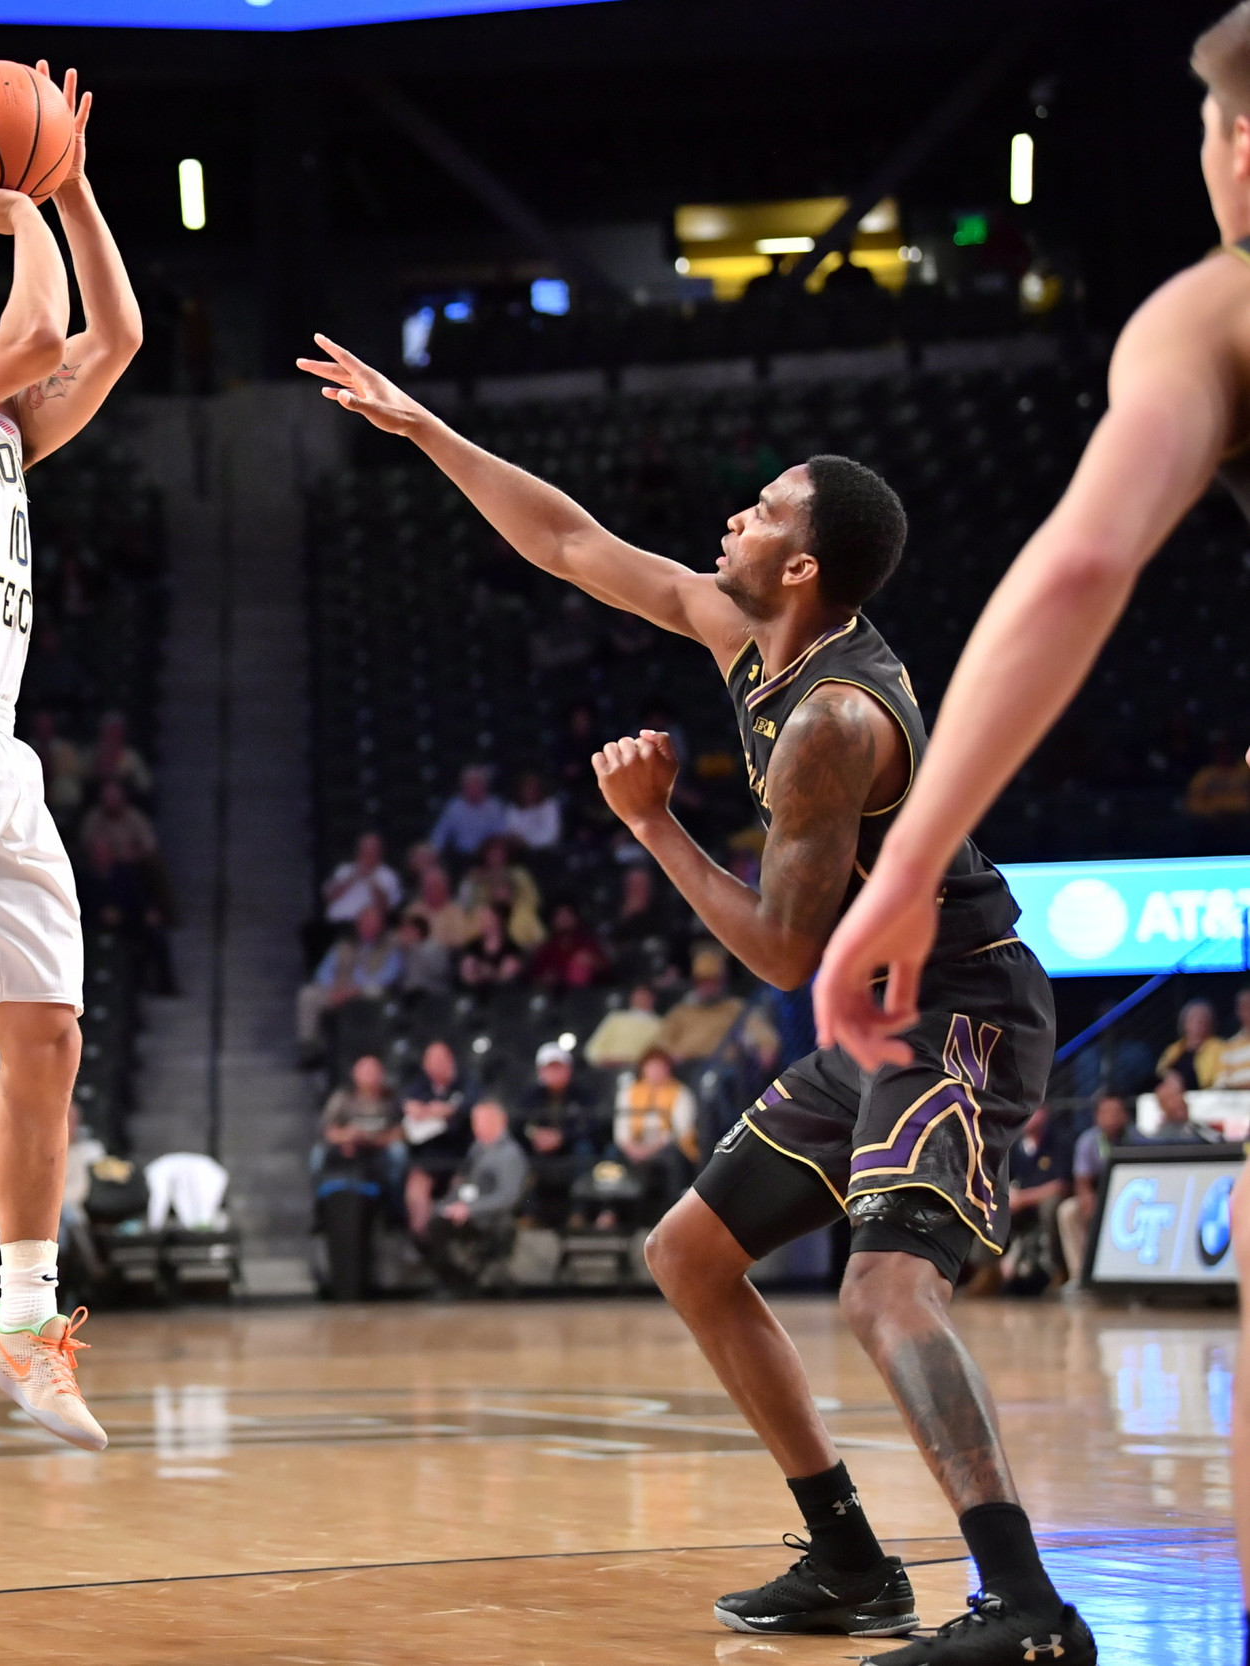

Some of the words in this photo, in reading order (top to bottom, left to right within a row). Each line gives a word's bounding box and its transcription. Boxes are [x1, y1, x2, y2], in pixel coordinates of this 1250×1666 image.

[9, 503, 29, 567] 10
[942, 1012, 1003, 1091] N
[1111, 1177, 1177, 1265] GT
